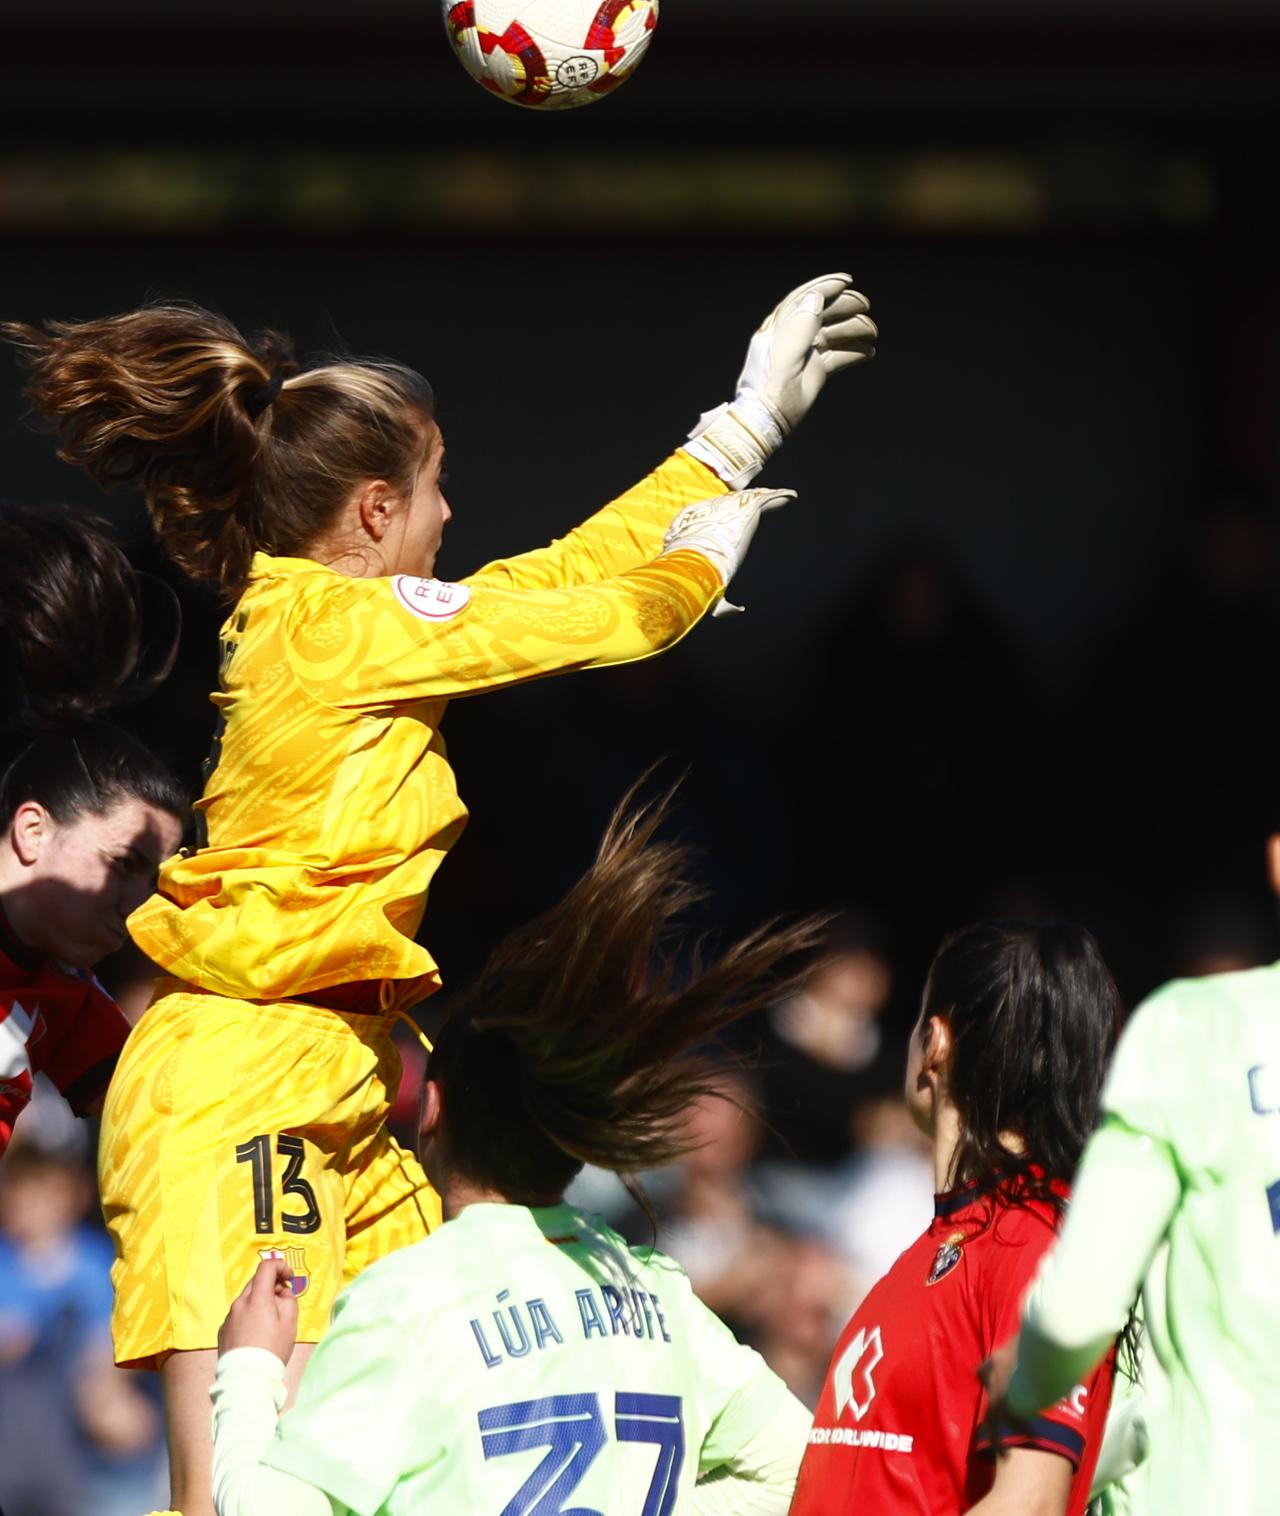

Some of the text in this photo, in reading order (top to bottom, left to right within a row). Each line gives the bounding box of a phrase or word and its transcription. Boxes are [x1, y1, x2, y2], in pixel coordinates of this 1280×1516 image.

[235, 1132, 322, 1235] 13
[470, 1284, 672, 1369] LÚA ARUFE
